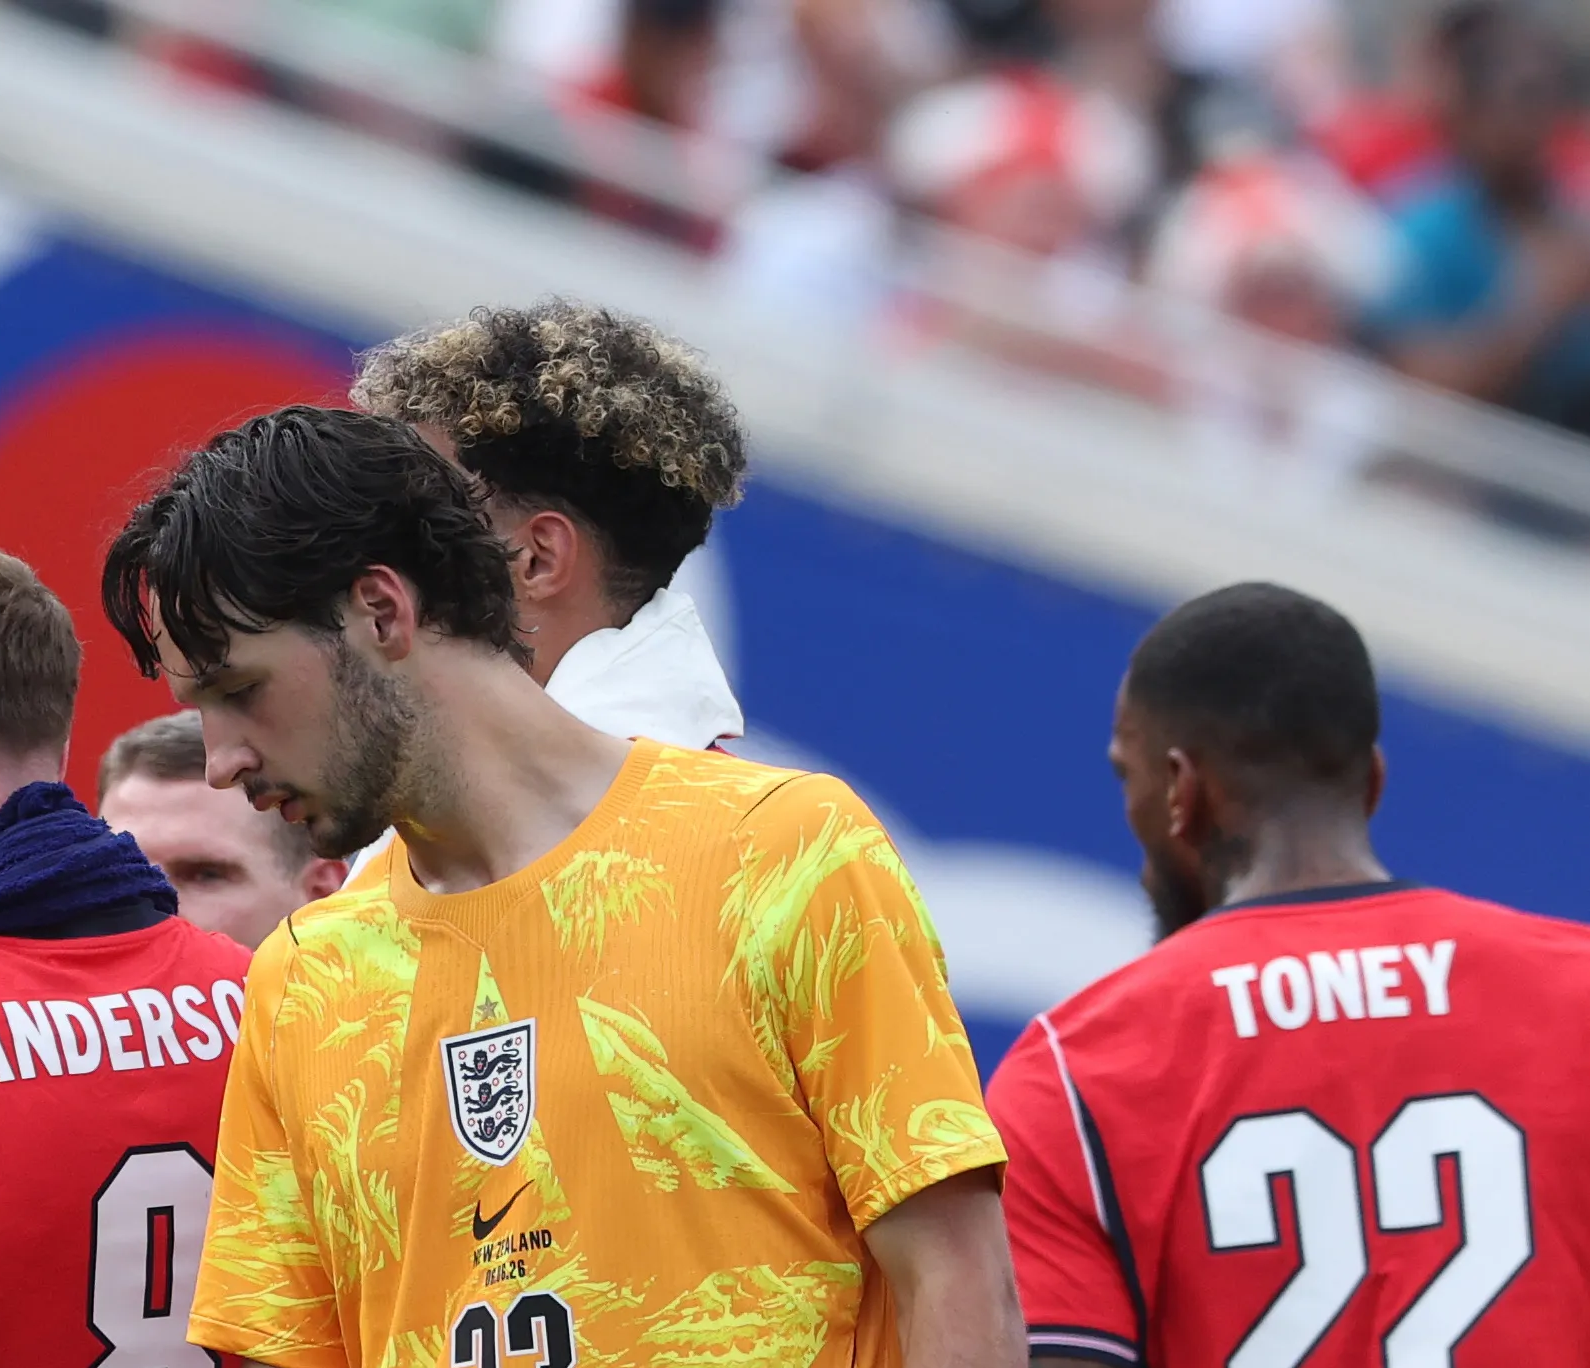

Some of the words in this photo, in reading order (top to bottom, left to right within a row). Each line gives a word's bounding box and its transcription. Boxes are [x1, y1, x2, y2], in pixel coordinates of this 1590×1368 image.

[1212, 940, 1457, 1038] TONEY
[473, 1243, 494, 1268] NEW
[495, 1229, 552, 1260] ZEALAND
